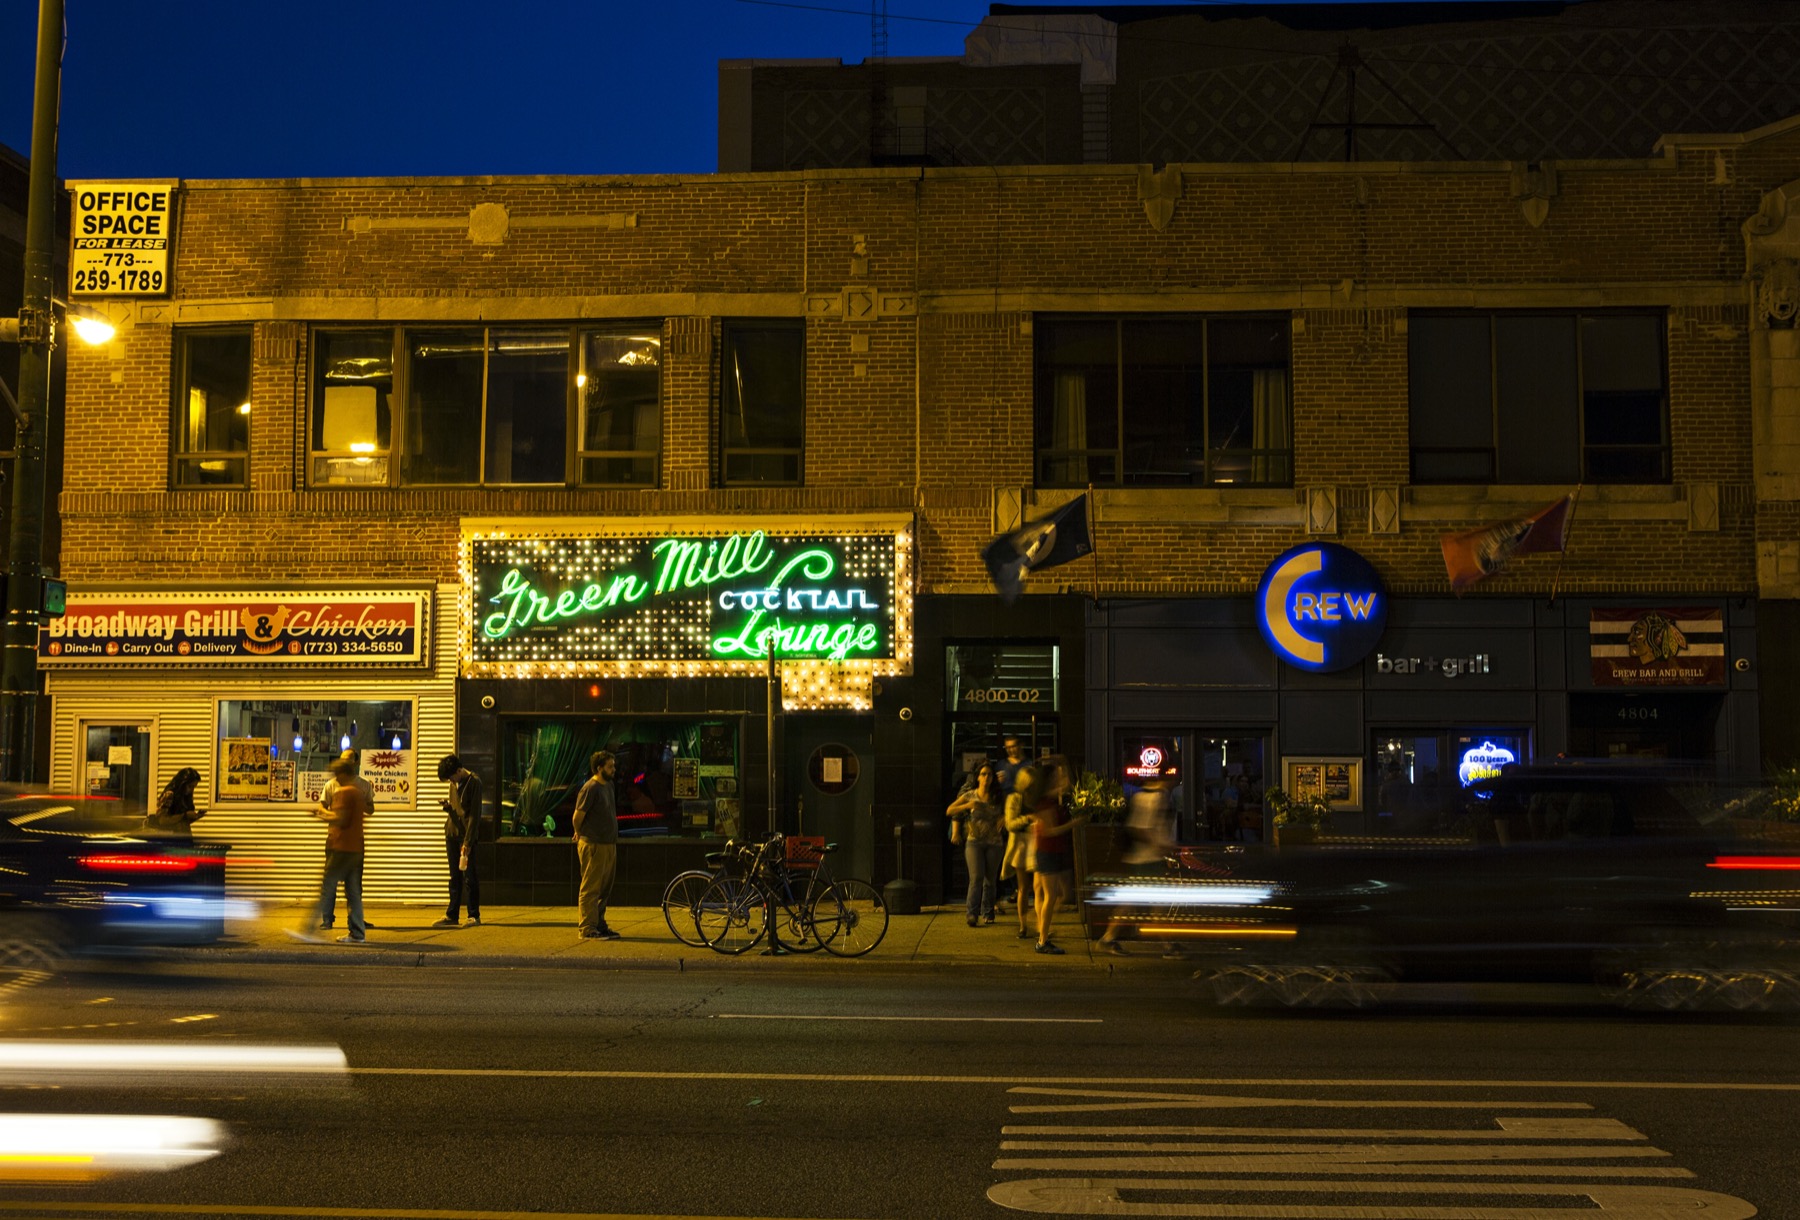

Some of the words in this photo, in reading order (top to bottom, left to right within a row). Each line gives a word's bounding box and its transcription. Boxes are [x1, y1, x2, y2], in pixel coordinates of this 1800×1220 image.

[79, 192, 166, 212] OFFICE
[82, 215, 161, 235] SPACE
[76, 239, 108, 249] FOR
[112, 239, 165, 249] LEASE
[75, 270, 163, 291] 259-1789
[484, 568, 648, 638] Green
[652, 530, 775, 595] Mill
[719, 586, 880, 610] COCKTAIL
[1264, 549, 1377, 664] CREW
[49, 610, 178, 640] Broadway
[184, 609, 238, 637] Grill
[254, 616, 273, 638] &
[286, 604, 407, 640] Chicken
[64, 642, 102, 653] Dine-In
[122, 643, 151, 655] Carry
[154, 642, 174, 653] Out
[193, 642, 236, 654] Delivery
[303, 641, 338, 655] (773)
[341, 641, 403, 653] 334-5650
[1376, 653, 1421, 674] bar
[1442, 653, 1490, 678] grill
[1612, 669, 1637, 678] CREW
[1639, 669, 1657, 678] BAR
[1659, 668, 1677, 678] AND
[1679, 668, 1704, 678] GRILL
[964, 688, 1040, 703] 4800-02
[1617, 707, 1659, 720] 4804
[1469, 755, 1485, 763] 100
[374, 784, 396, 793] $8.50
